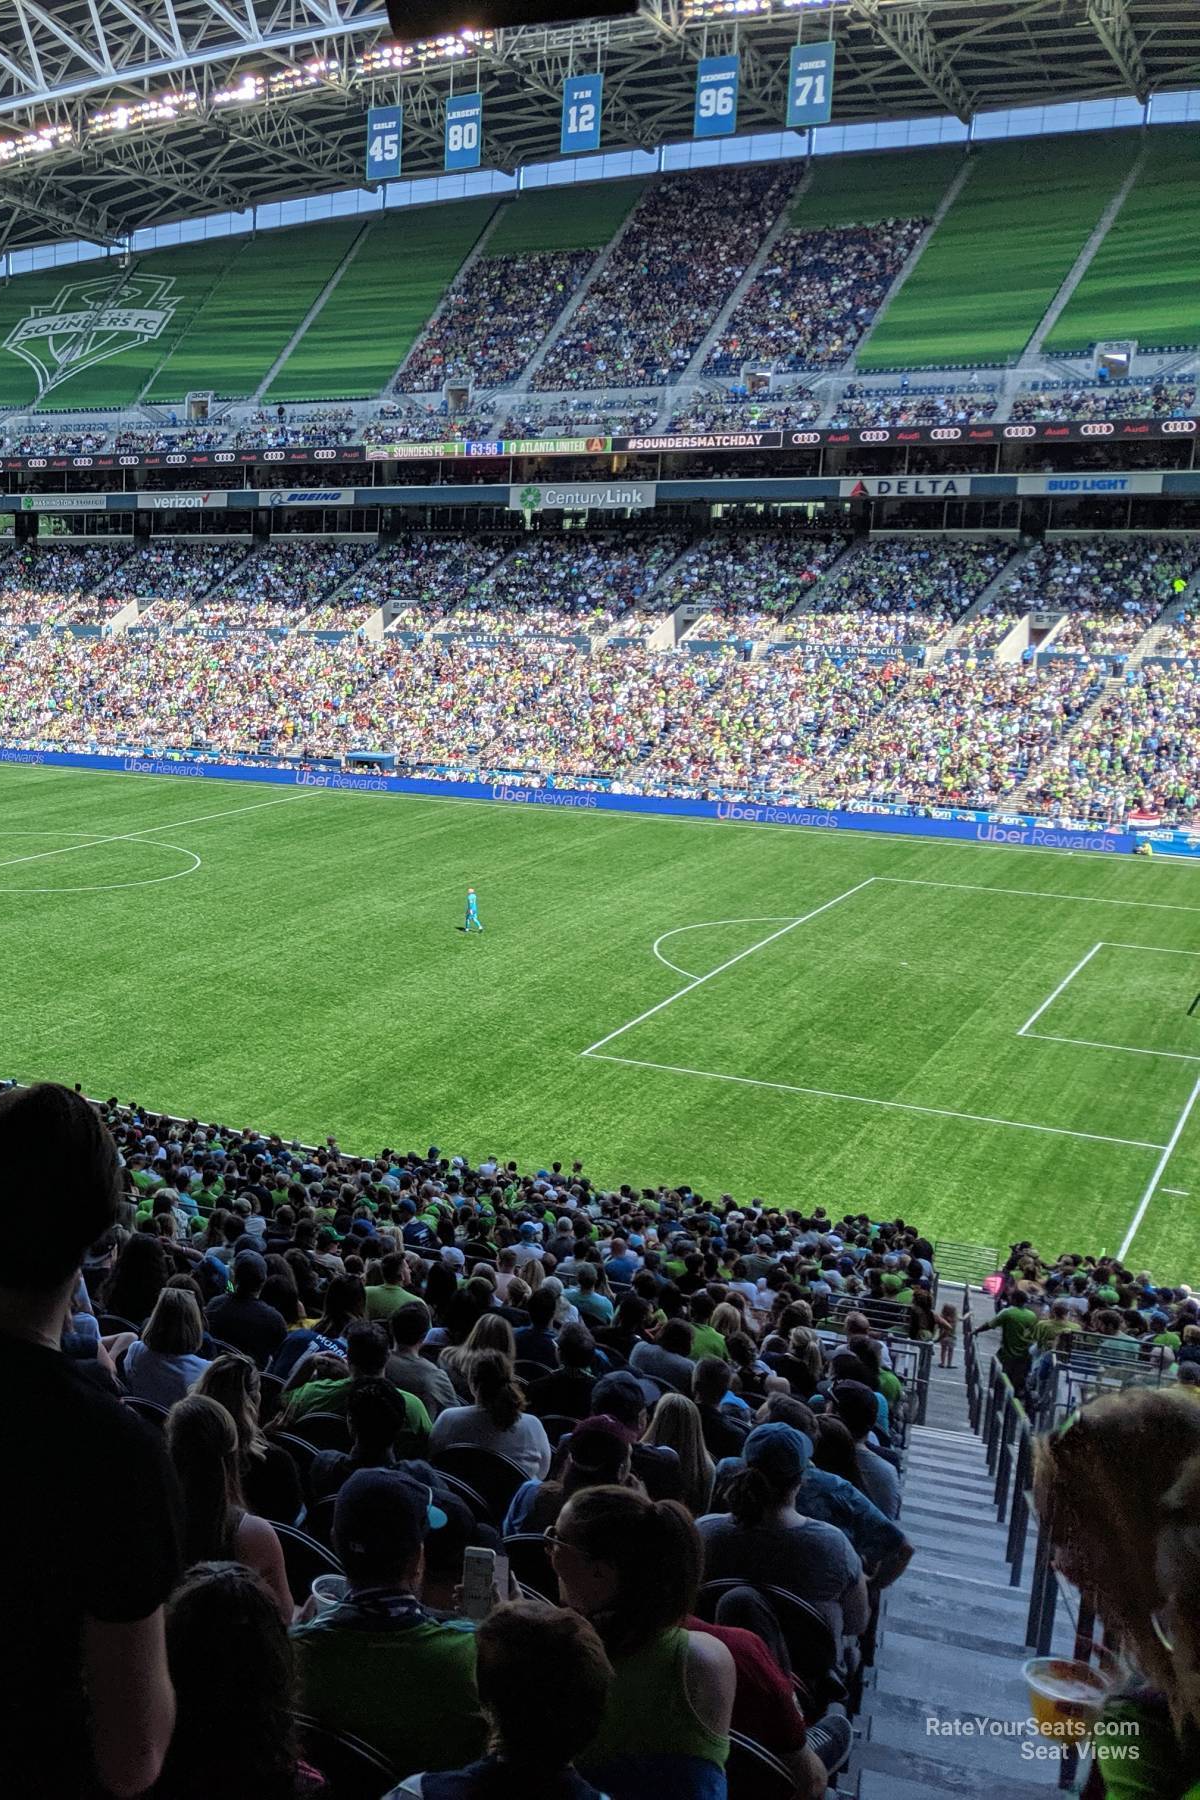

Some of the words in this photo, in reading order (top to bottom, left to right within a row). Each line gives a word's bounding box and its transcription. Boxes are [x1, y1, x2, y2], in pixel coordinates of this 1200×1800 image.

[795, 75, 825, 106] 71
[699, 87, 734, 117] 96
[568, 104, 595, 133] 12
[448, 122, 477, 151] 80
[369, 134, 398, 162] 45
[133, 317, 157, 330] FC
[896, 432, 920, 440] Audi
[969, 429, 993, 438] Audi
[1044, 427, 1069, 436] Audi
[1123, 425, 1148, 433] Audi
[627, 435, 763, 450] #SOUNDERSMATCHDAY
[828, 434, 850, 443] Audi
[393, 446, 430, 457] SOUNDERS
[432, 445, 444, 456] FC
[454, 444, 458, 456] 1
[471, 443, 497, 455] 63:56
[510, 442, 516, 454] 0
[520, 441, 555, 453] ATLANTA
[556, 440, 585, 452] UNITED
[878, 480, 957, 494] DELTA
[1048, 480, 1080, 491] BUD
[1082, 479, 1128, 491] LIGHT
[153, 494, 203, 508] verizon
[286, 492, 341, 502] BOEING
[545, 489, 643, 505] CenturyLink
[805, 645, 842, 654] DELTA
[2, 750, 44, 764] Rewards
[124, 758, 154, 772] Uber
[156, 760, 204, 776] Rewards
[296, 772, 330, 786] Uber
[332, 774, 388, 791] Rewards
[492, 786, 532, 802] Uber
[534, 788, 598, 808] Rewards
[717, 802, 764, 820] Uber
[766, 808, 838, 828] Rewards
[977, 824, 1031, 844] Uber
[1032, 828, 1116, 852] Rewards
